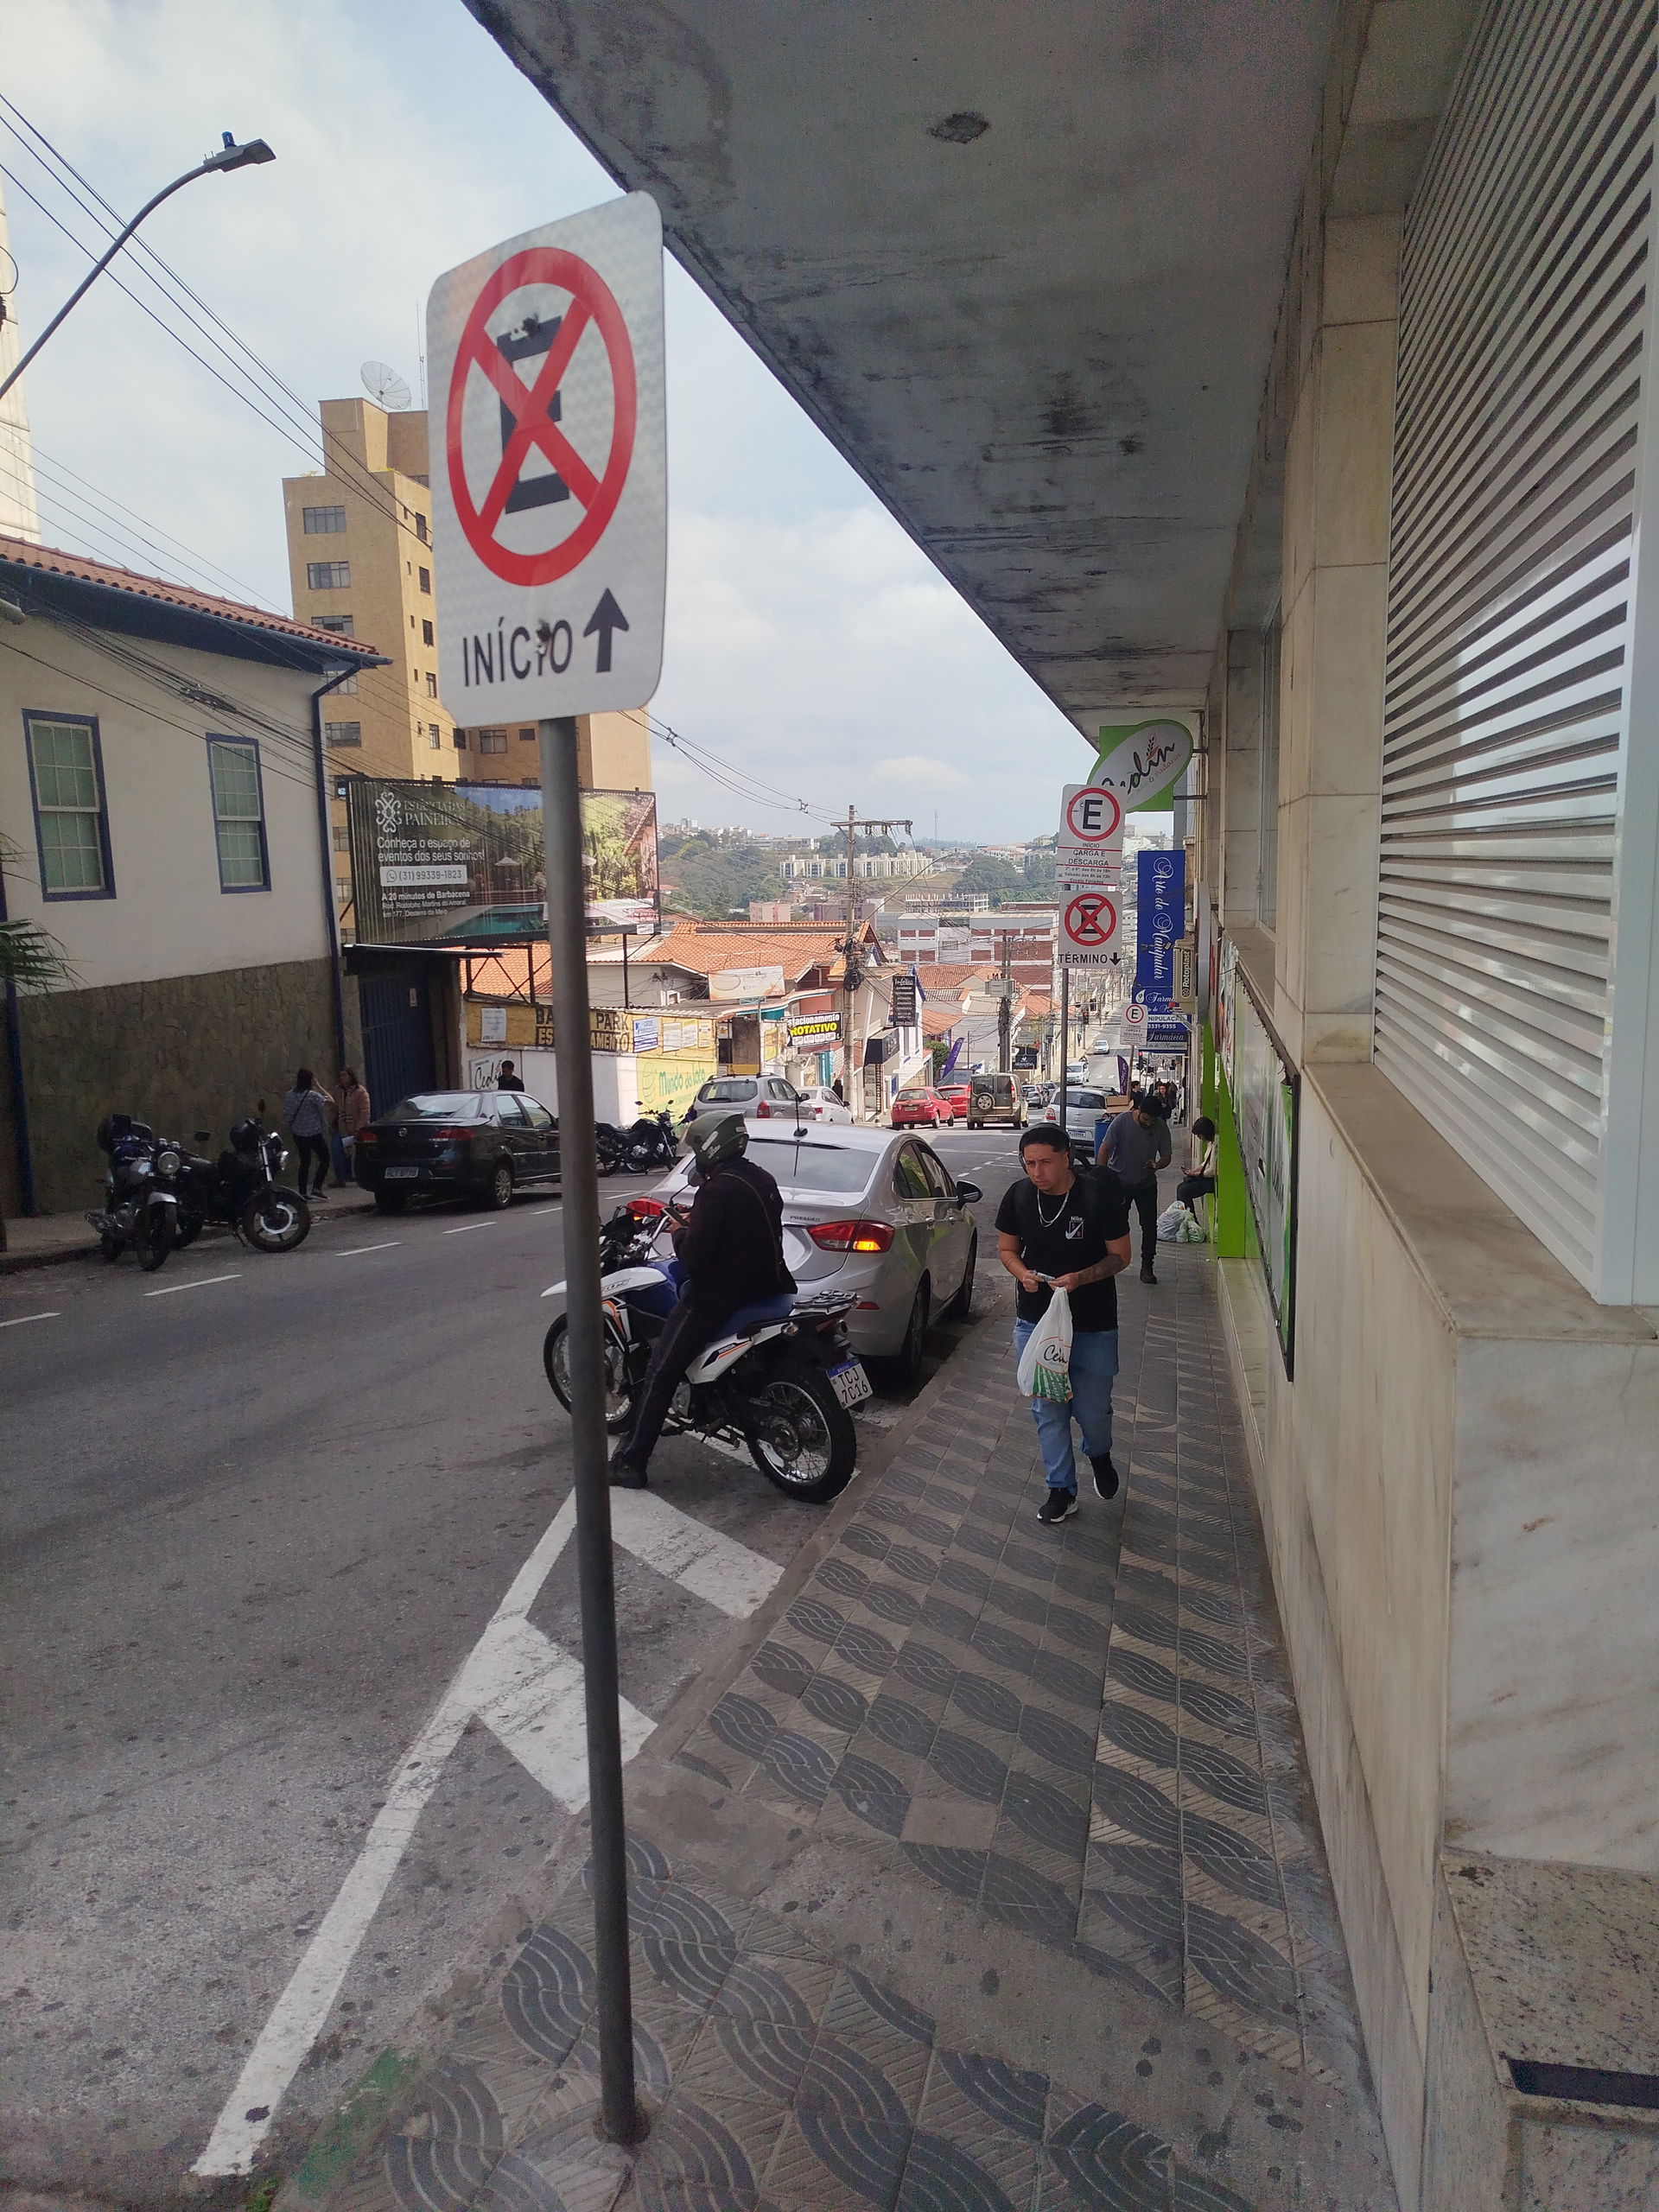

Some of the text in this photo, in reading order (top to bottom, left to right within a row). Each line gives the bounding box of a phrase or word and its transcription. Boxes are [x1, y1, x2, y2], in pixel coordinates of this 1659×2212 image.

[1082, 799, 1103, 830] E
[377, 836, 471, 851] Conheça o espaço de
[378, 851, 413, 862] eventos
[415, 849, 430, 862] dos
[432, 851, 453, 861] seus
[398, 869, 462, 881] (31) 99339-1823
[388, 893, 397, 901] 20
[398, 892, 426, 900] minutos
[427, 891, 435, 899] de
[436, 890, 471, 899] Barbacena
[1154, 897, 1170, 911] de
[1148, 912, 1173, 981] Manipular
[1058, 951, 1108, 964] TÉRMINO
[1182, 951, 1191, 988] Rotoplast
[785, 1013, 840, 1027] stacionamento
[1131, 1008, 1139, 1020] E
[595, 1011, 629, 1032] PARK
[790, 1022, 837, 1036] ROTATIVO
[837, 1368, 860, 1388] TCJ
[841, 1380, 868, 1404] 7C16
